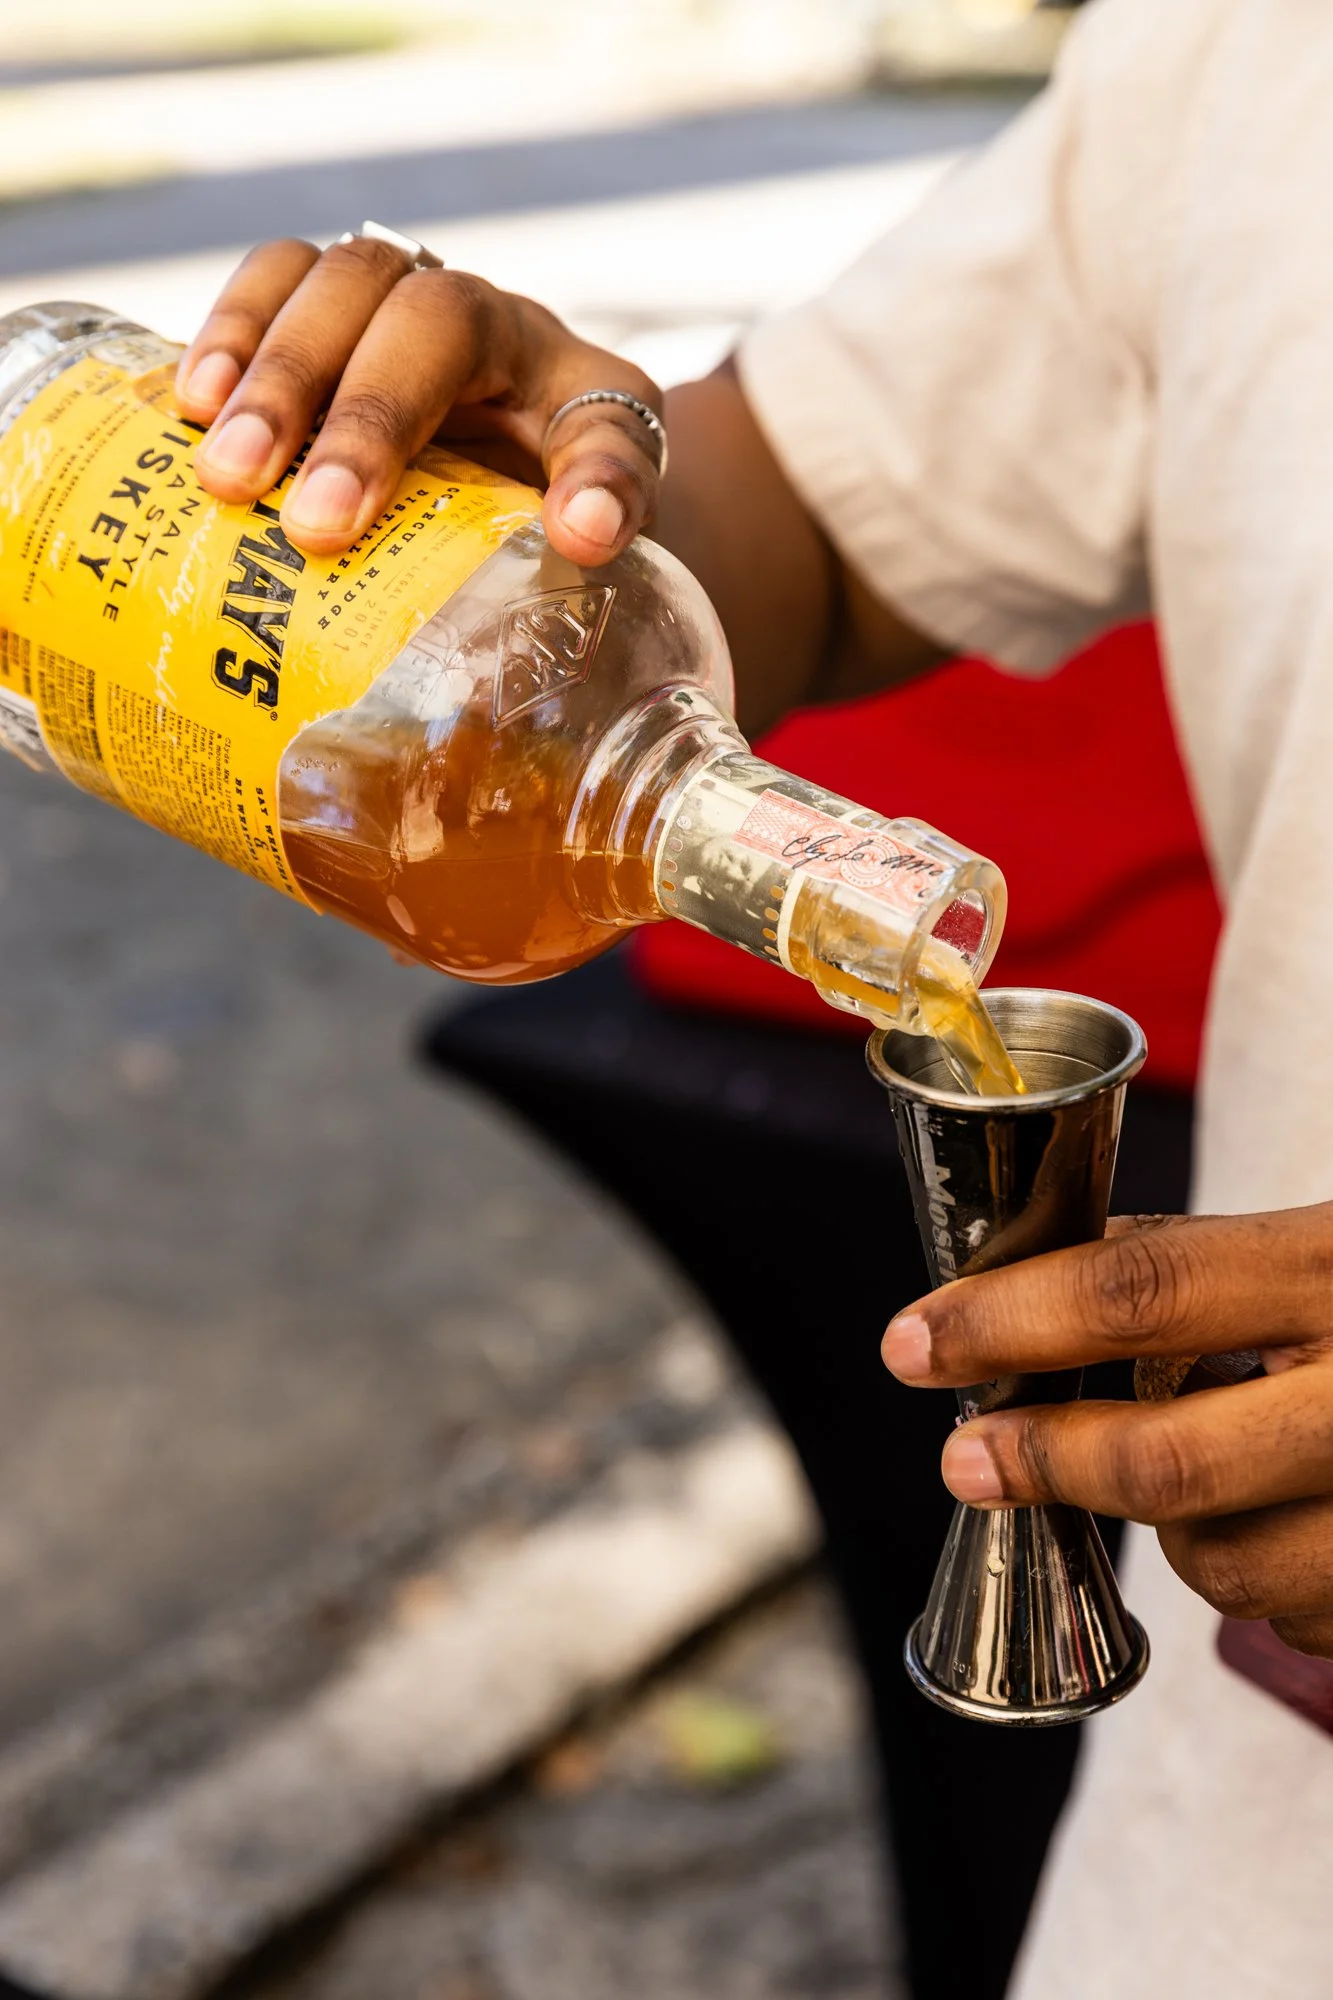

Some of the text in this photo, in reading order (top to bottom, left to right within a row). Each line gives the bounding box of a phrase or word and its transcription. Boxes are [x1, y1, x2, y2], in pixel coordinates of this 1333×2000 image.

[102, 504, 165, 622] STYLE
[317, 488, 429, 601] DISTILLERY
[317, 487, 460, 630] COECUH RIDGE
[388, 566, 421, 600] LEGAL
[333, 599, 377, 652] 2001
[361, 608, 388, 649] SINCE
[235, 777, 243, 796] BE
[255, 787, 269, 816] SAY
